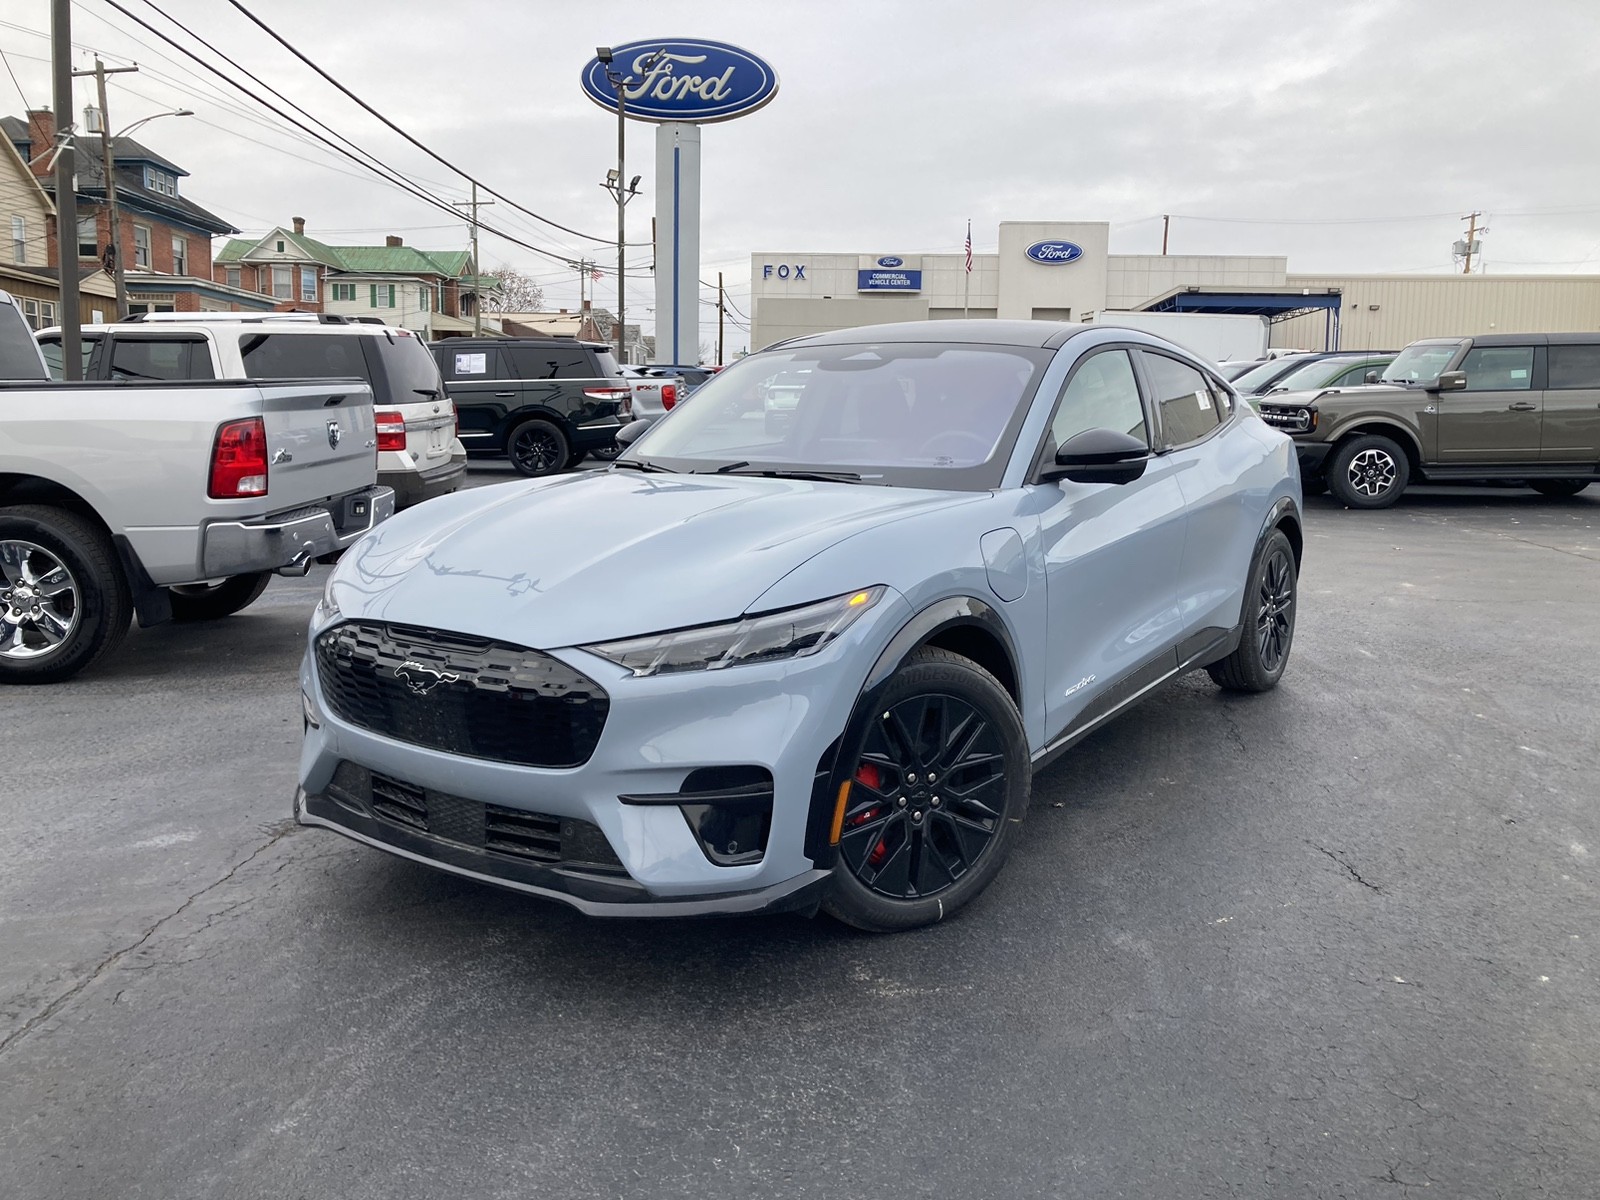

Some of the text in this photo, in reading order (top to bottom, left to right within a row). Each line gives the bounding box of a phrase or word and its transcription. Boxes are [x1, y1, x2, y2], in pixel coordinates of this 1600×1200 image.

[622, 52, 736, 100] Ford
[1038, 244, 1072, 259] Ford
[763, 264, 806, 279] FOX
